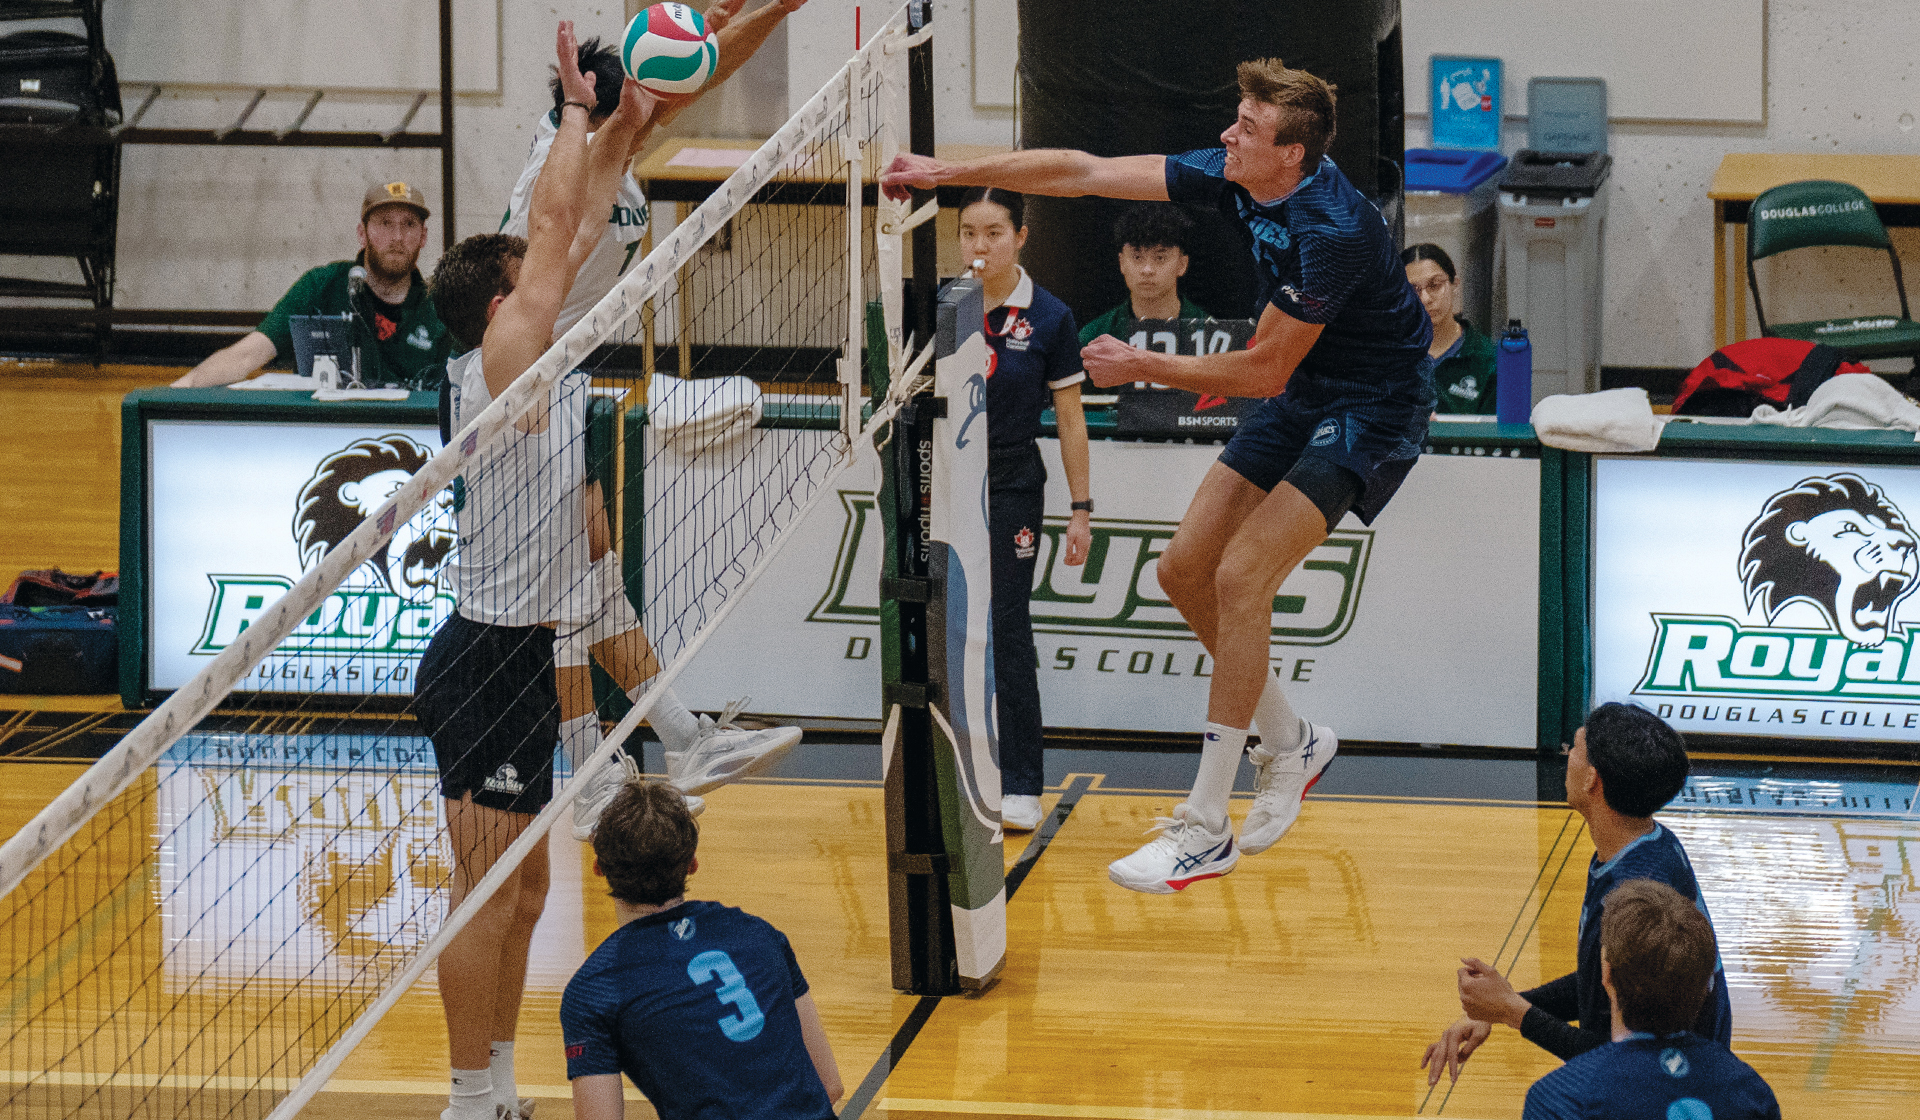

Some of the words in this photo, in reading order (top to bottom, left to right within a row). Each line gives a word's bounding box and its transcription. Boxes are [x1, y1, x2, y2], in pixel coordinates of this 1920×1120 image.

[1097, 650, 1316, 682] COLLE
[1657, 703, 1809, 725] DOUGLAS
[687, 950, 765, 1042] 3
